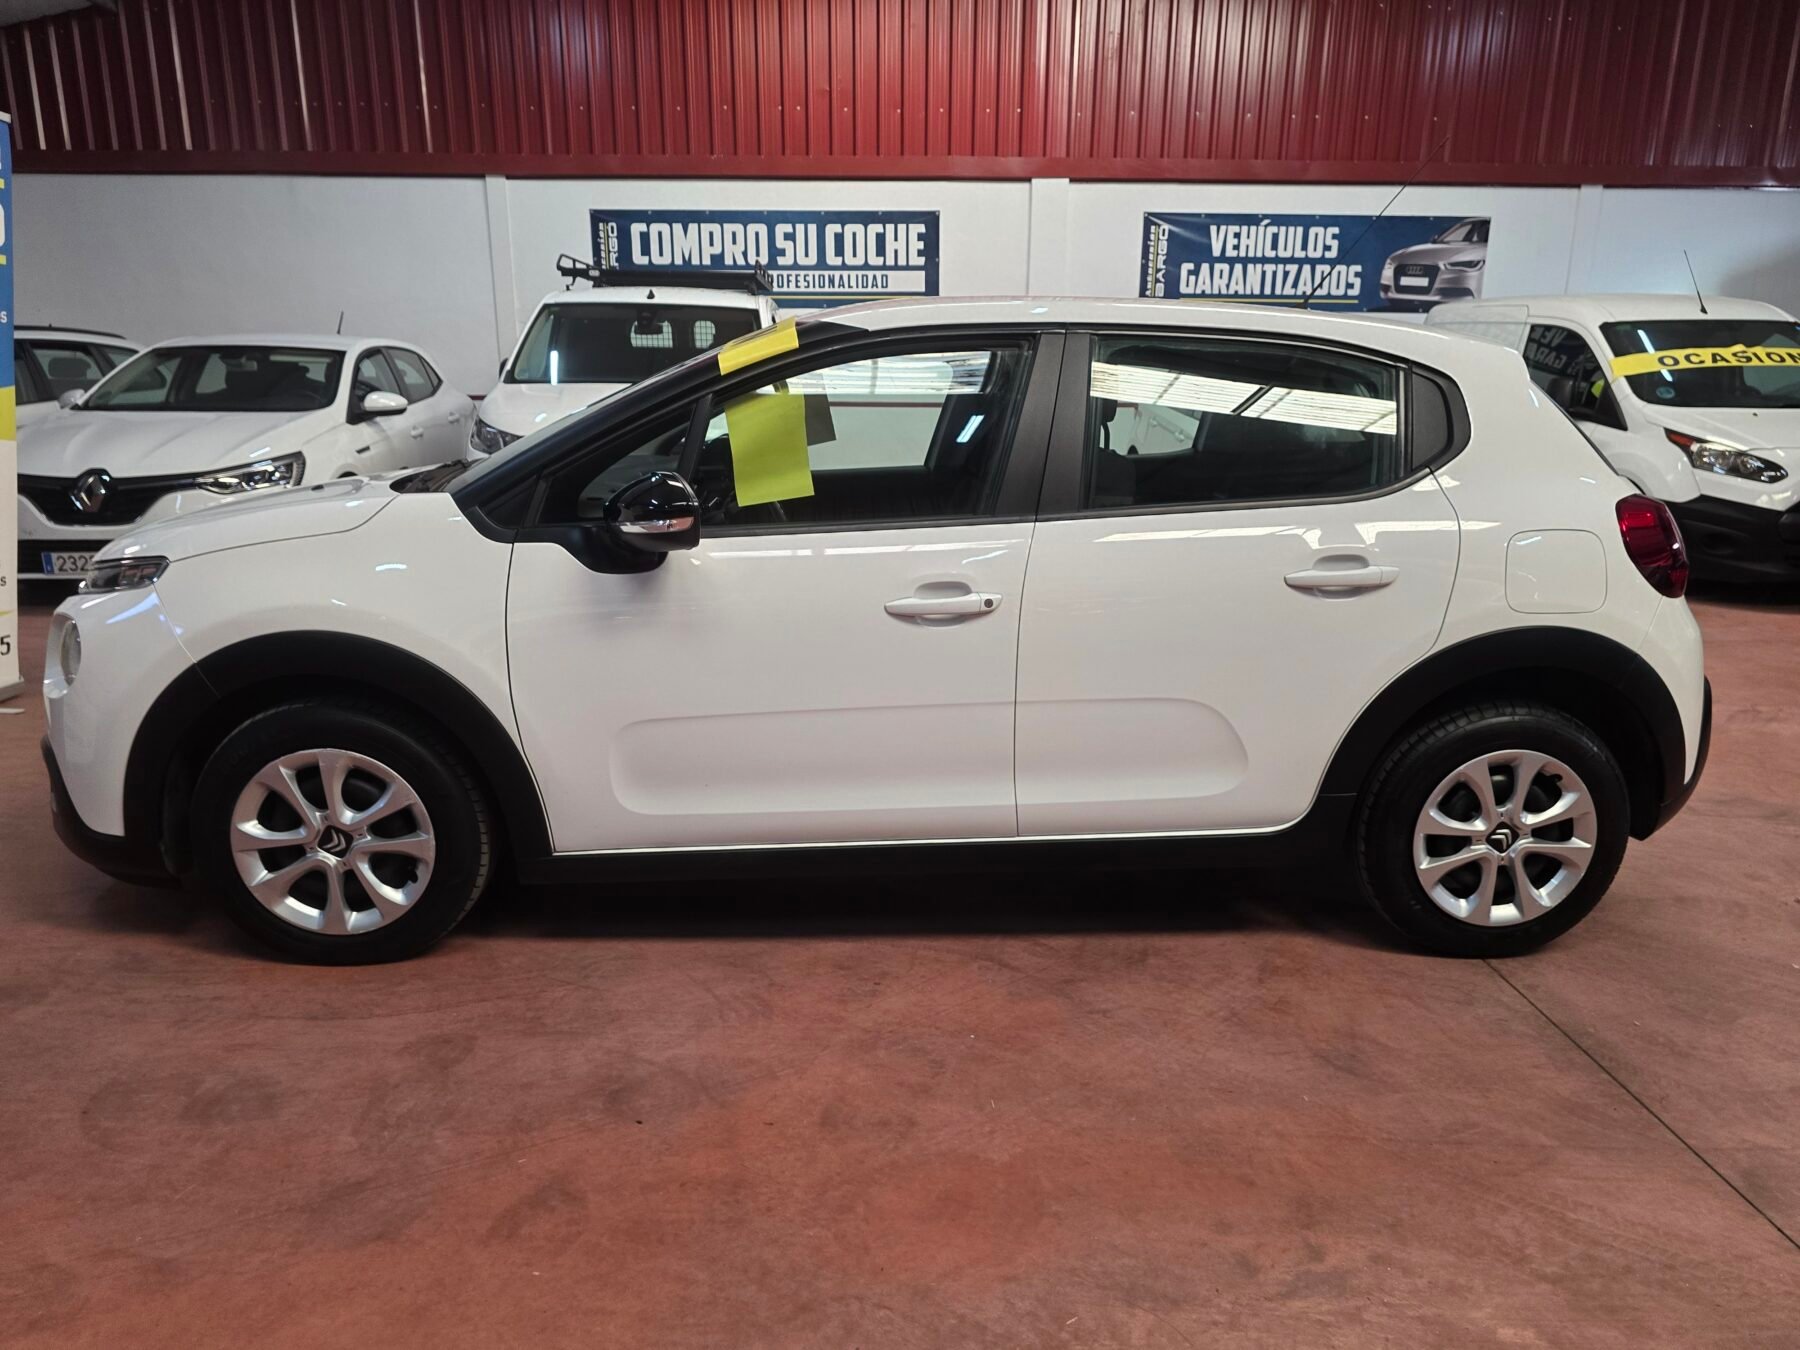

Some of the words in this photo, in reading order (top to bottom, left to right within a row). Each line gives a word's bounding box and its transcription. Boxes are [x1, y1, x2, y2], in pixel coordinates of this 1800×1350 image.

[608, 222, 619, 270] RGO
[630, 222, 769, 266] COMPRO
[775, 223, 818, 266] SU
[824, 223, 926, 267] COCHE
[1209, 219, 1340, 259] VEHÍCULOS
[1179, 262, 1362, 297] GARANTIZADOS
[56, 555, 95, 572] 232
